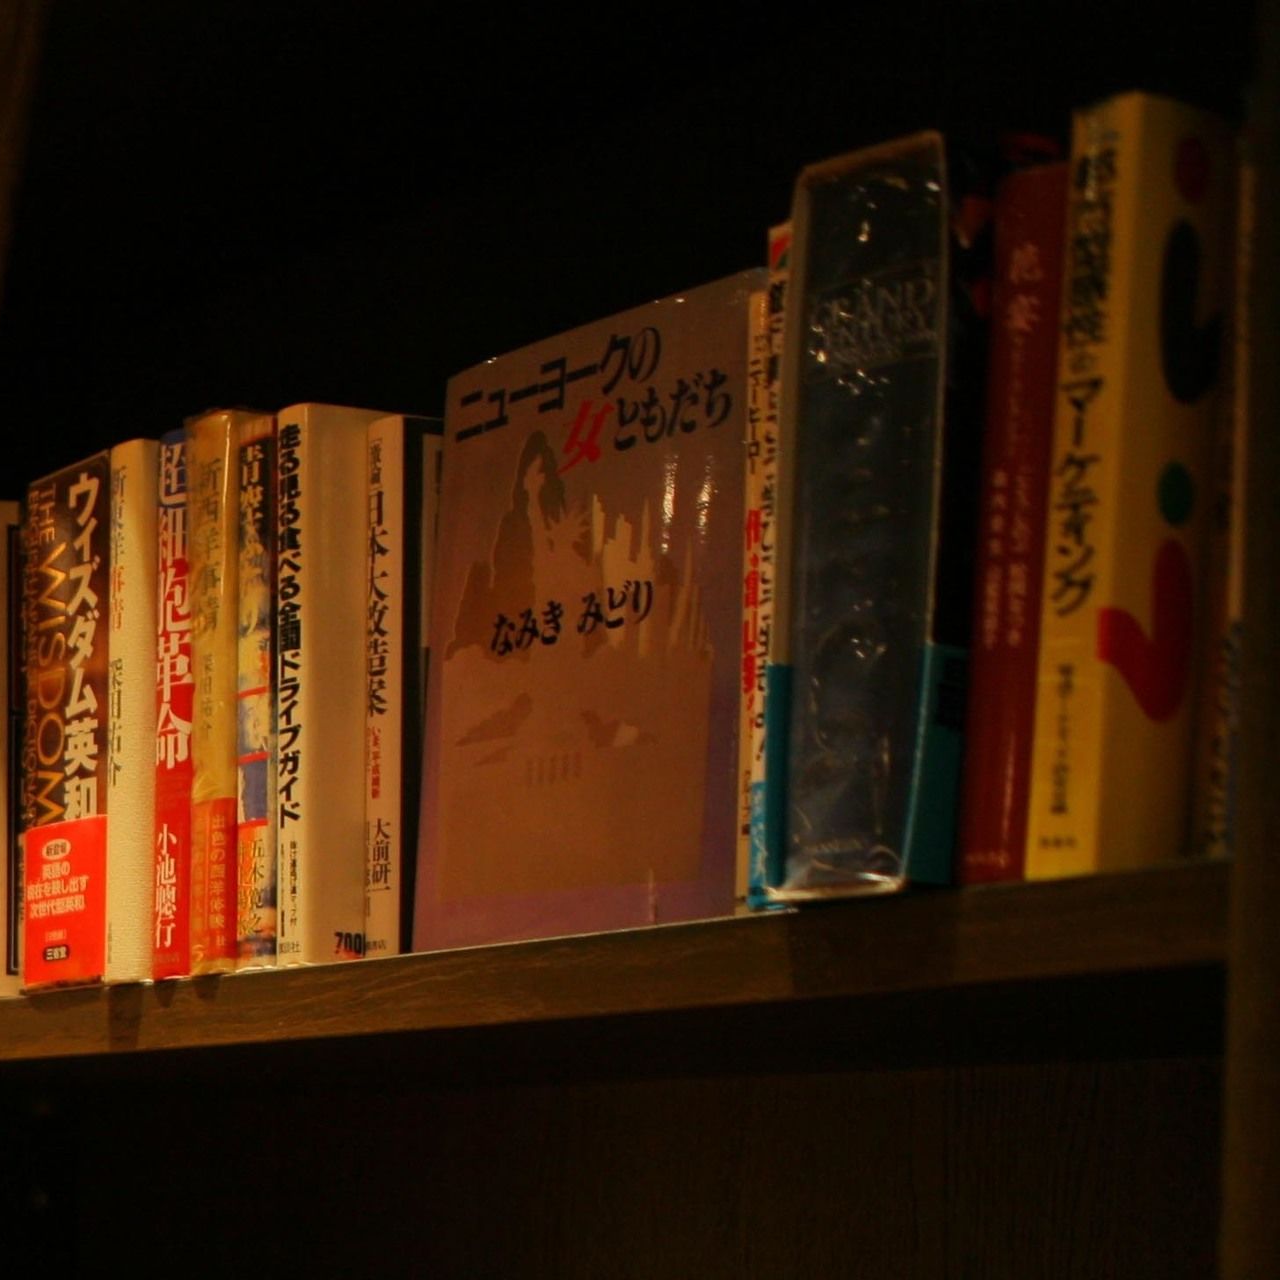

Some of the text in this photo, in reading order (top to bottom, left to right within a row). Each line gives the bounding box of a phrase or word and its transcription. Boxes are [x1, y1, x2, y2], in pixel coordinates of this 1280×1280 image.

[455, 326, 661, 444] ニューヨークの
[555, 368, 733, 476] 女ともだち
[37, 484, 68, 827] THE WISDOM
[156, 440, 194, 769] 超細胞革命
[278, 424, 303, 829] 走る見る食べる全国ドライブガイド
[490, 579, 654, 656] なみき みどり
[371, 818, 391, 892] 大前研一
